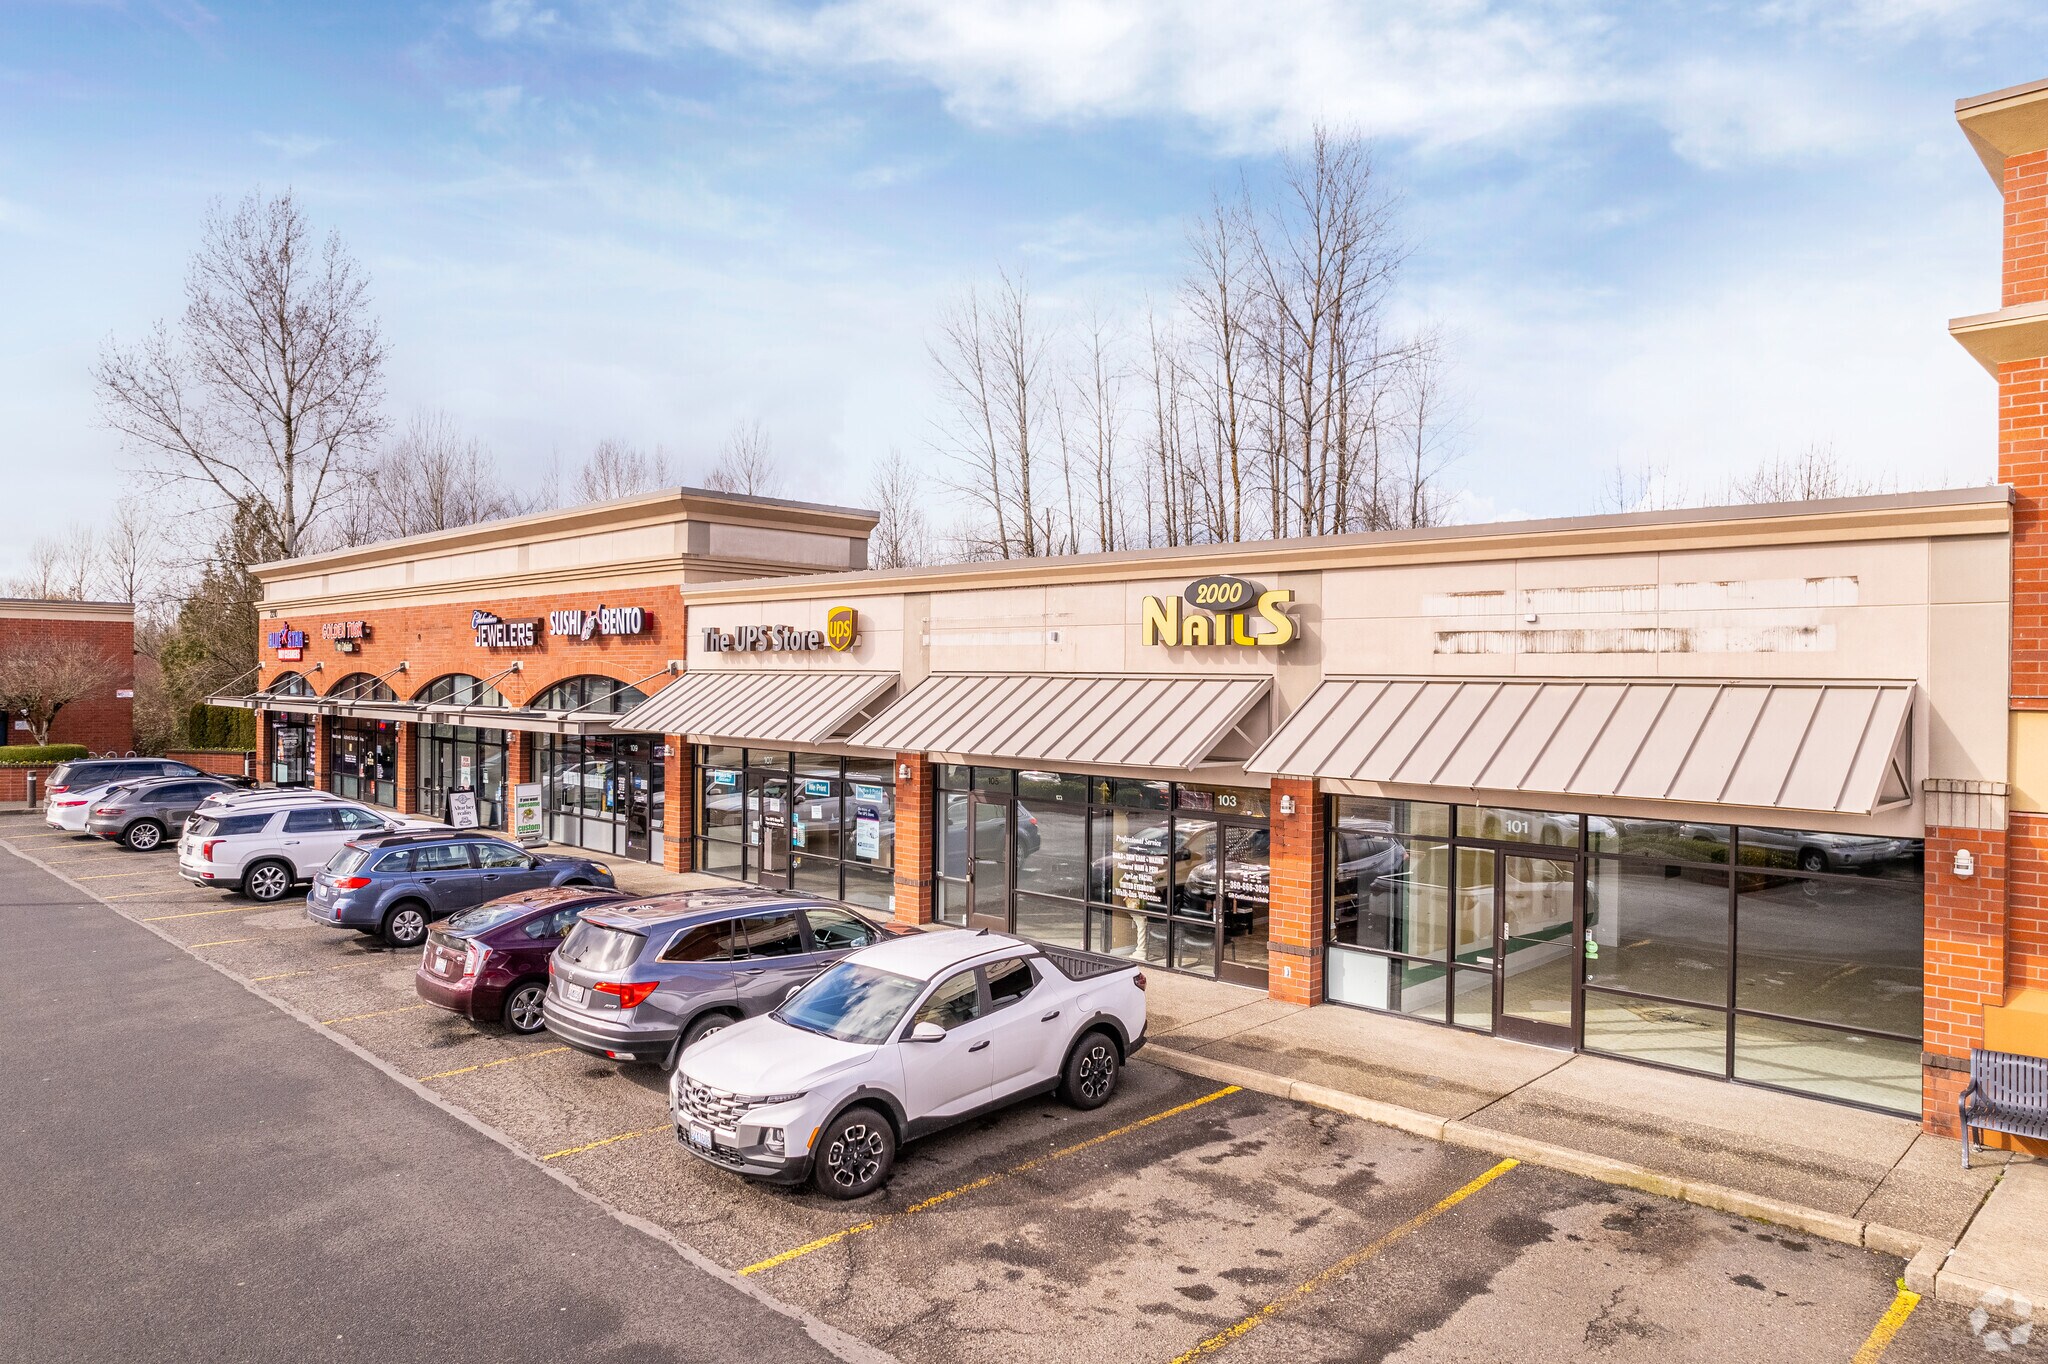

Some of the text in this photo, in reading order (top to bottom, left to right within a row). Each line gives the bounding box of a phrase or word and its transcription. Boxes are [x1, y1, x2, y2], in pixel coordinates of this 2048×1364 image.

[1196, 582, 1243, 604] 2000
[550, 607, 642, 635] SUSHI BENTO
[322, 622, 346, 640] GOLDEN
[475, 623, 533, 647] JEWELERS
[702, 624, 820, 652] The UPS Store
[830, 620, 850, 644] ups
[268, 631, 303, 649] BLUE STAR
[630, 744, 638, 752] 109
[764, 756, 773, 765] 107
[816, 784, 827, 793] Print
[1218, 795, 1237, 807] 103
[518, 824, 540, 832] custom
[1505, 820, 1529, 834] 101
[1116, 834, 1162, 847] Professional Service
[1138, 891, 1162, 902] Welcome
